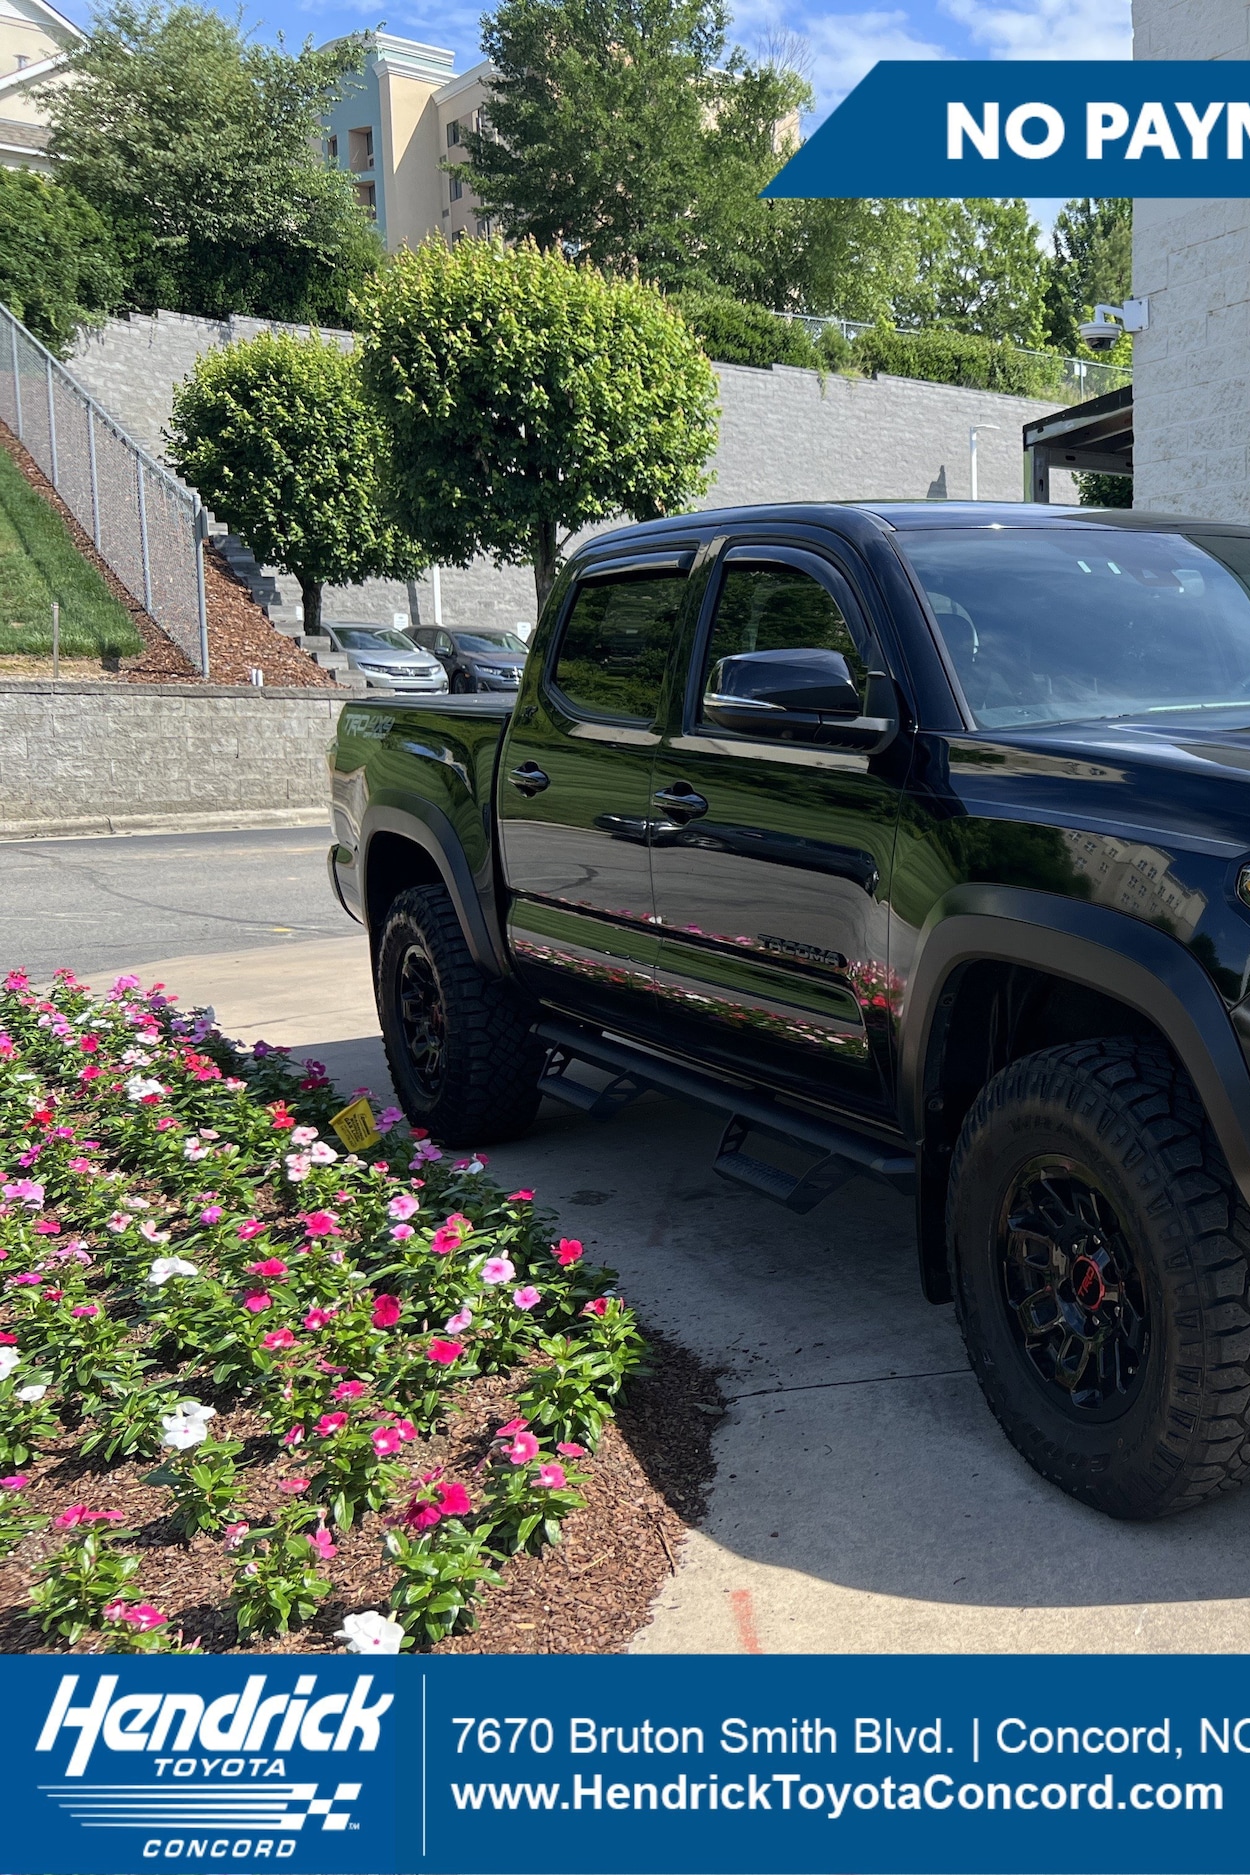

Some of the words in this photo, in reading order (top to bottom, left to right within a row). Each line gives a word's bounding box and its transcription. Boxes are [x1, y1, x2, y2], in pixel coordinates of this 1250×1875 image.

[345, 713, 370, 736] TRD
[757, 934, 847, 967] TACOMA
[1077, 1265, 1095, 1297] TRD
